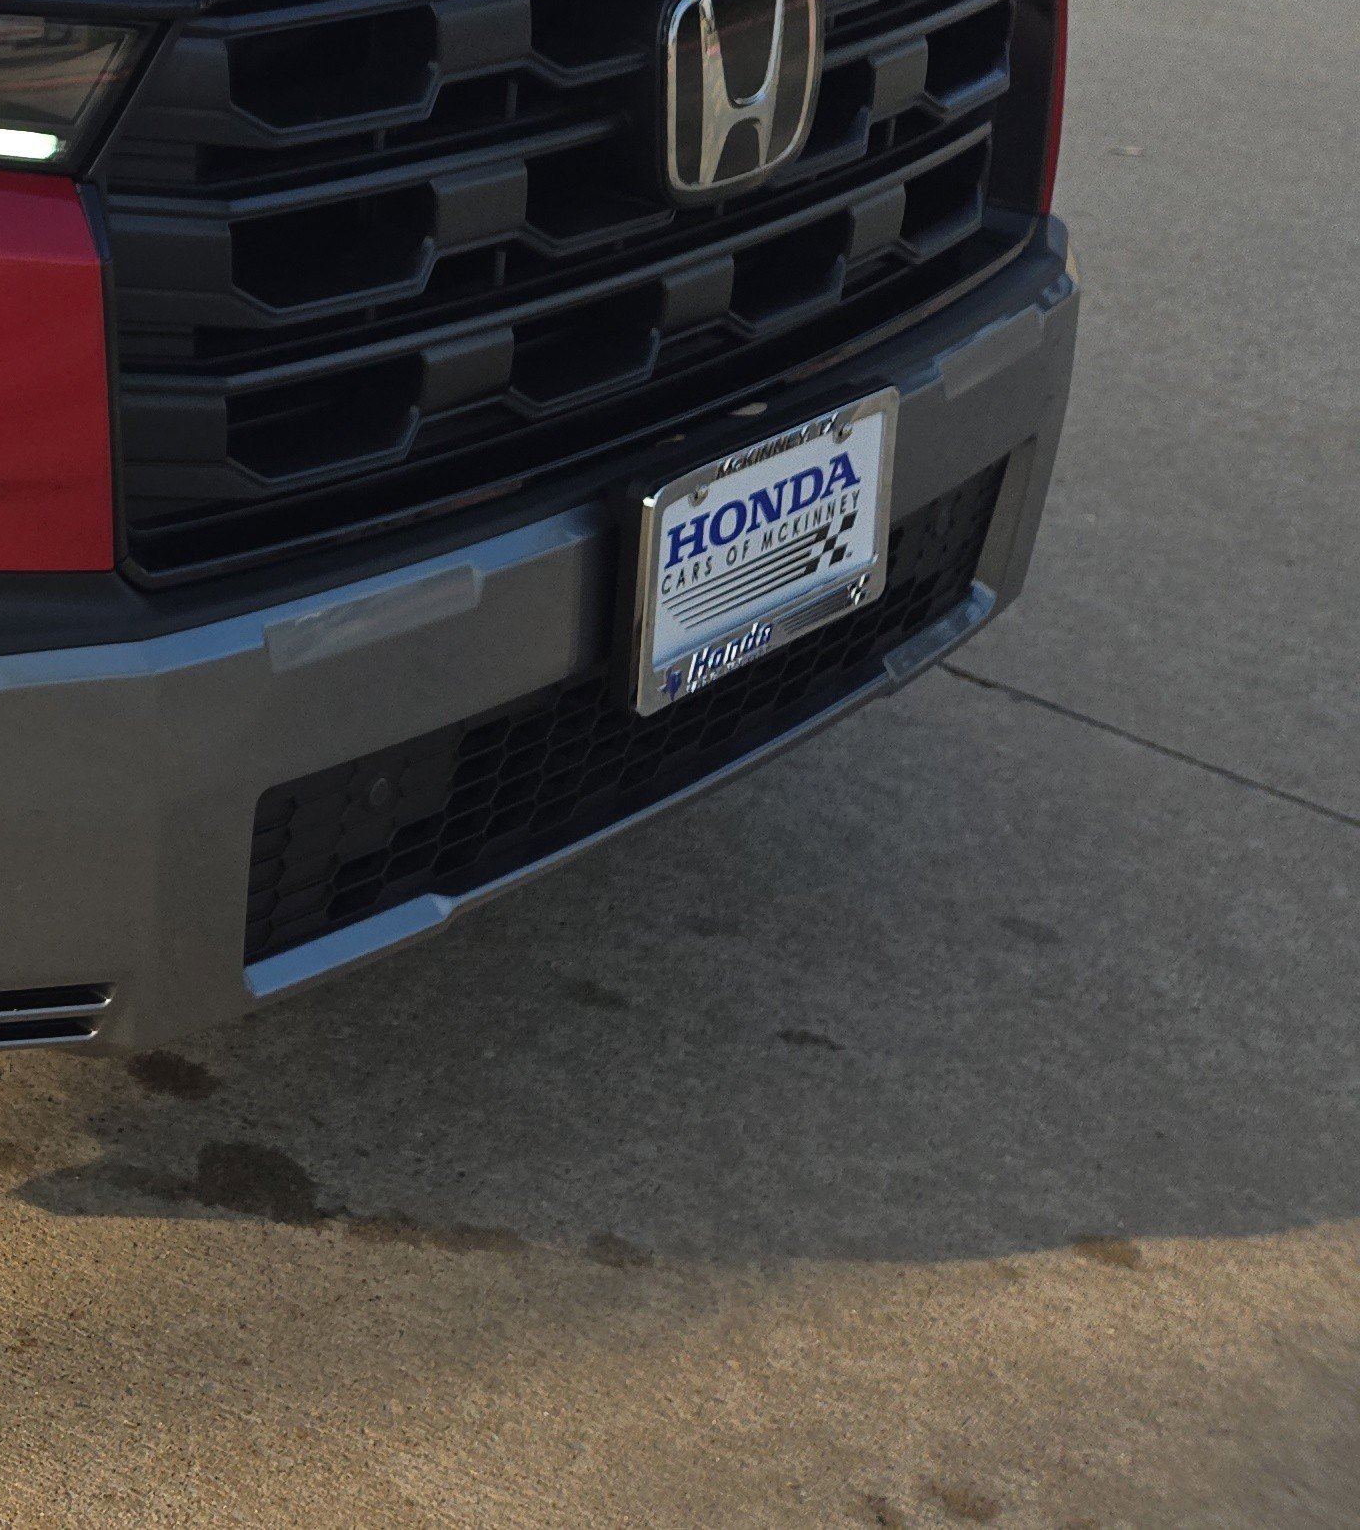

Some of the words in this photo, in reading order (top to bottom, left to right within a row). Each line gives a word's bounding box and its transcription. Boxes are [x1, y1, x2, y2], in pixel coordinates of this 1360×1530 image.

[661, 555, 714, 595] CARS
[726, 537, 750, 568] OF
[761, 489, 861, 552] MCKINNEY
[664, 451, 860, 570] HONDA
